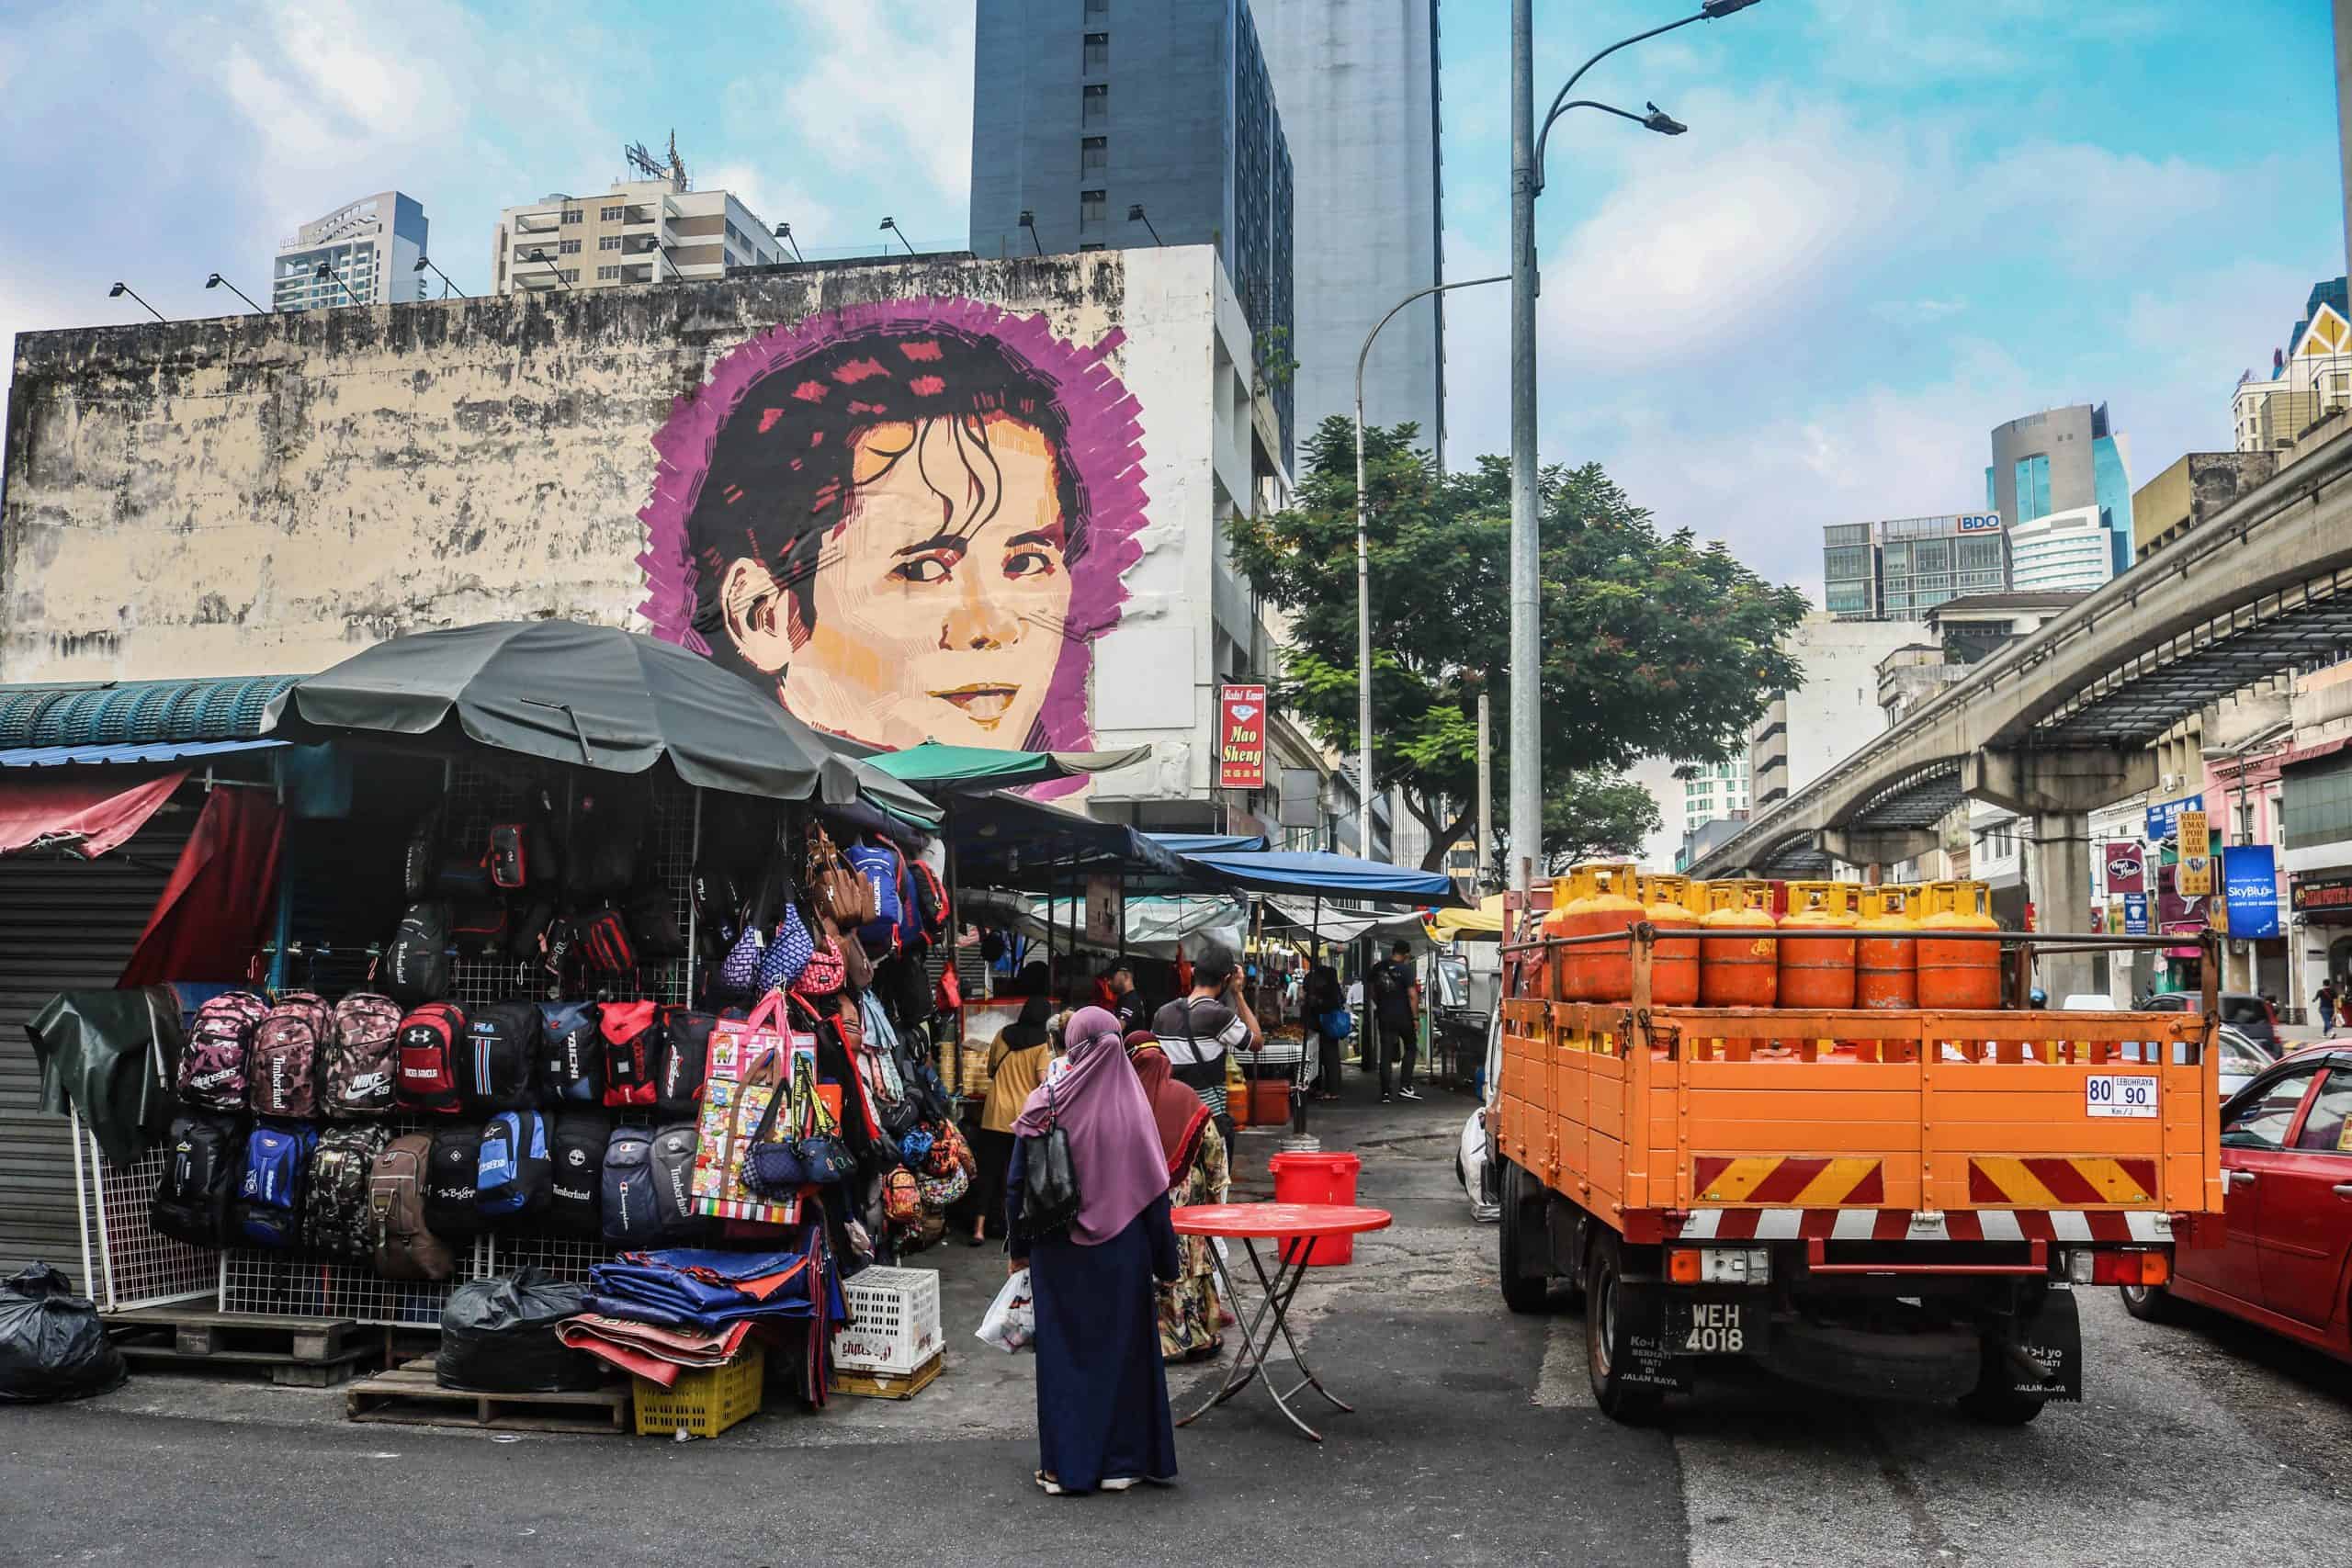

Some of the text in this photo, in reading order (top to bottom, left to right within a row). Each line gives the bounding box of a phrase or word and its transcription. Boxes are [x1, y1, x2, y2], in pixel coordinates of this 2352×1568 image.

[1962, 514, 1999, 530] BDO
[1230, 725, 1257, 743] Mao
[1222, 745, 1262, 766] Sheng
[473, 1022, 494, 1033] FILA
[273, 1055, 287, 1109] Timberland
[352, 1071, 383, 1089] NIKE
[2116, 1077, 2153, 1086] LEBUHRAYA
[374, 1086, 390, 1096] SB
[2090, 1079, 2110, 1100] 80
[2125, 1088, 2145, 1104] 90
[552, 1183, 591, 1200] Timberland
[671, 1165, 692, 1217] Timberland
[1692, 1304, 1740, 1327] WEH
[1685, 1328, 1743, 1351] 4018
[2047, 1348, 2064, 1359] yo
[1639, 1359, 1661, 1368] HATI
[1645, 1367, 1655, 1375] DI
[1621, 1373, 1678, 1387] JALAN RAYA
[2013, 1383, 2042, 1393] JALAN
